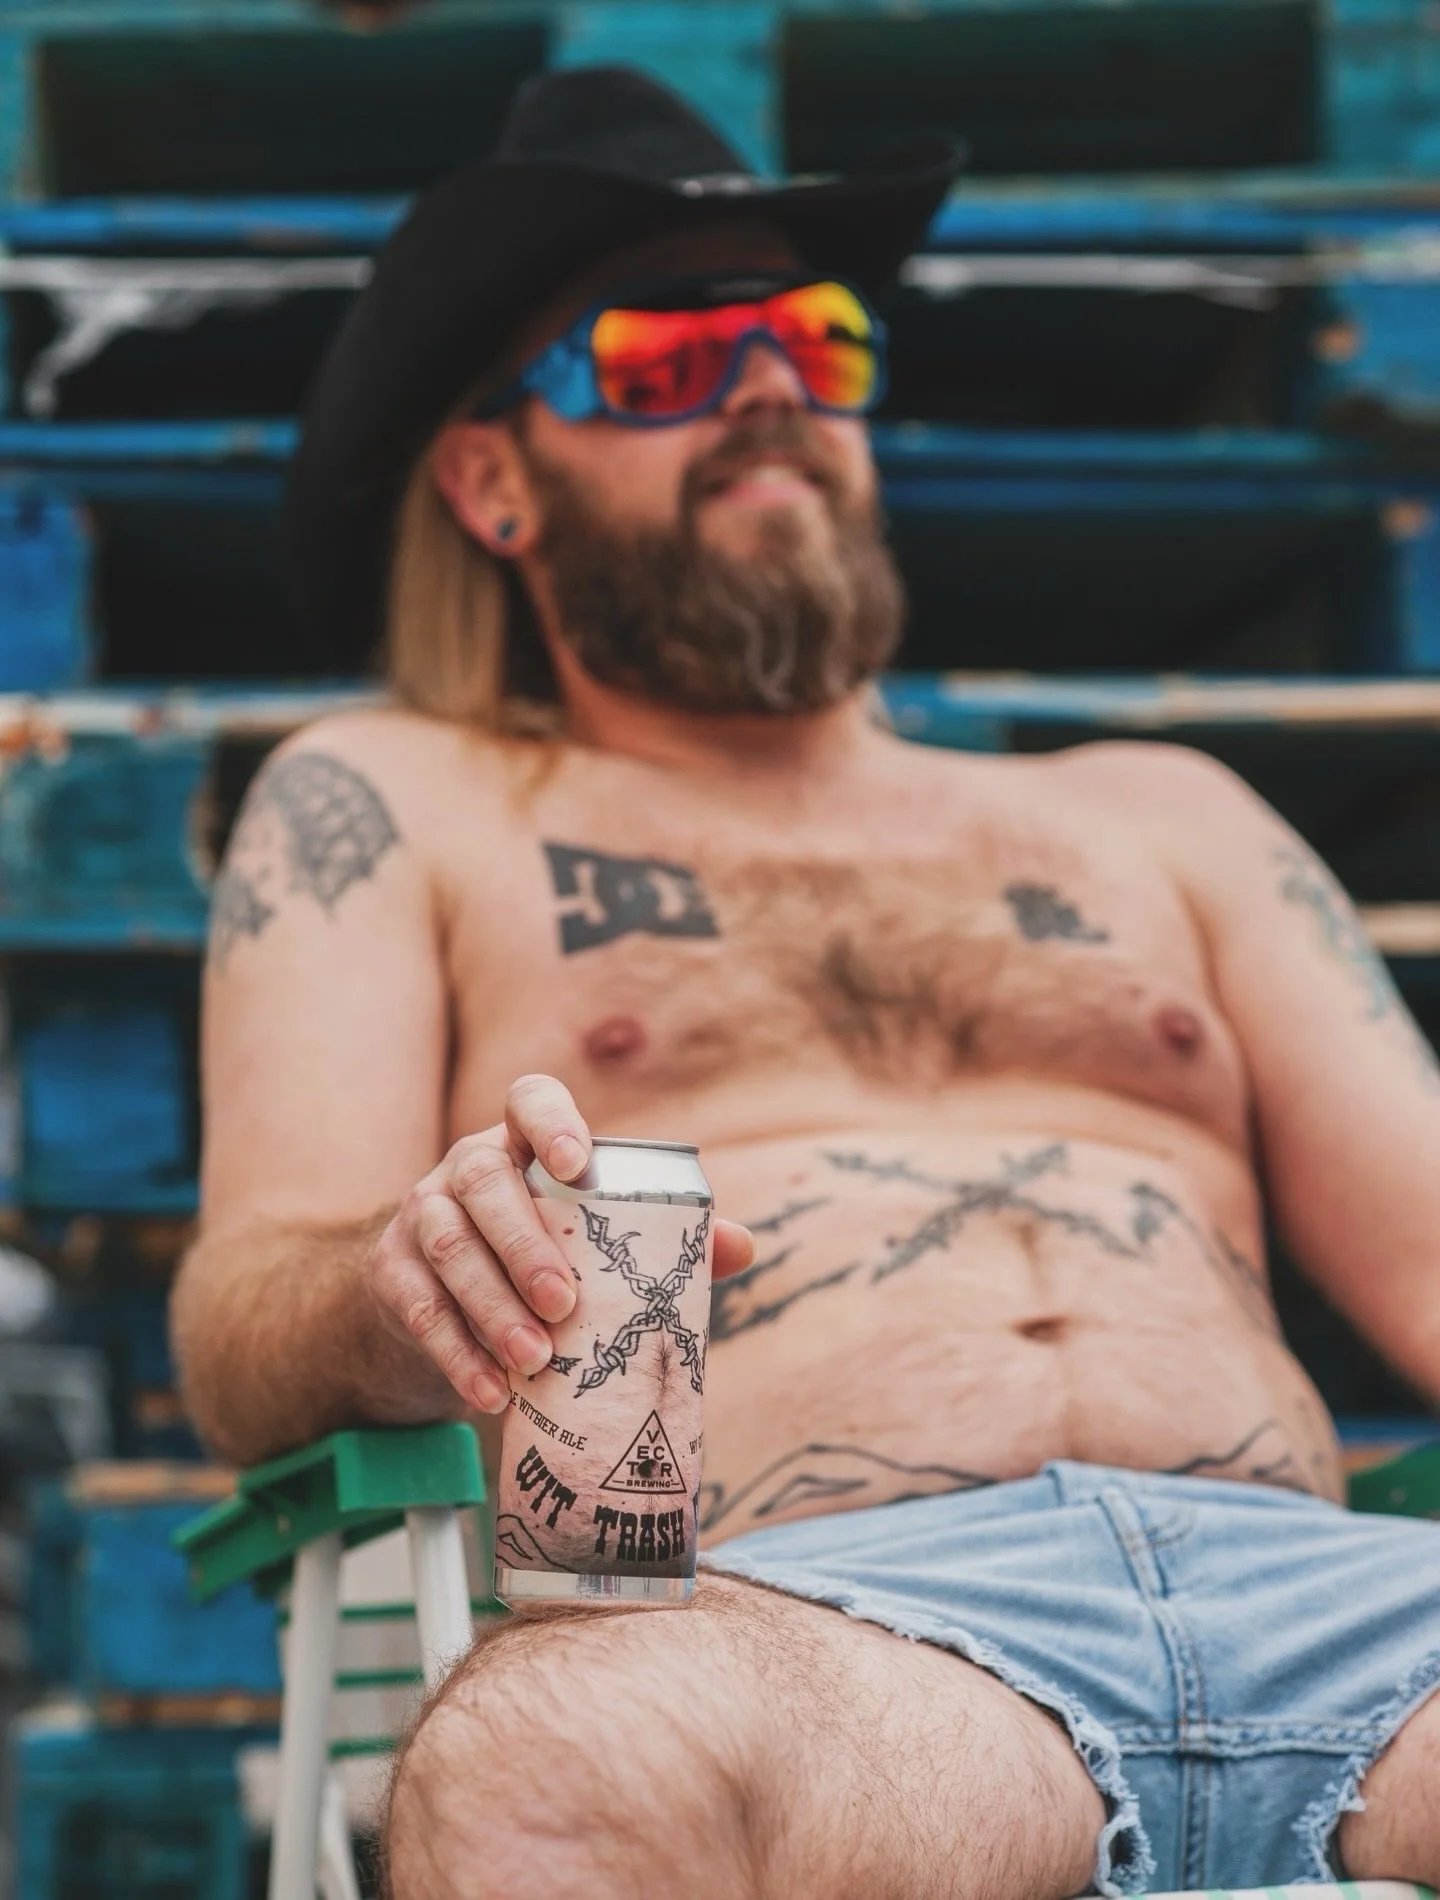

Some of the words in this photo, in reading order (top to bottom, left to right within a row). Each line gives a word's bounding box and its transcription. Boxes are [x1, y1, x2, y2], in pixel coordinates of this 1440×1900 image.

[519, 1396, 560, 1438] WITBIER
[558, 1429, 588, 1451] ALE
[515, 1444, 578, 1530] WIT
[593, 1504, 686, 1562] TRASH
[626, 1479, 671, 1488] BREWING
